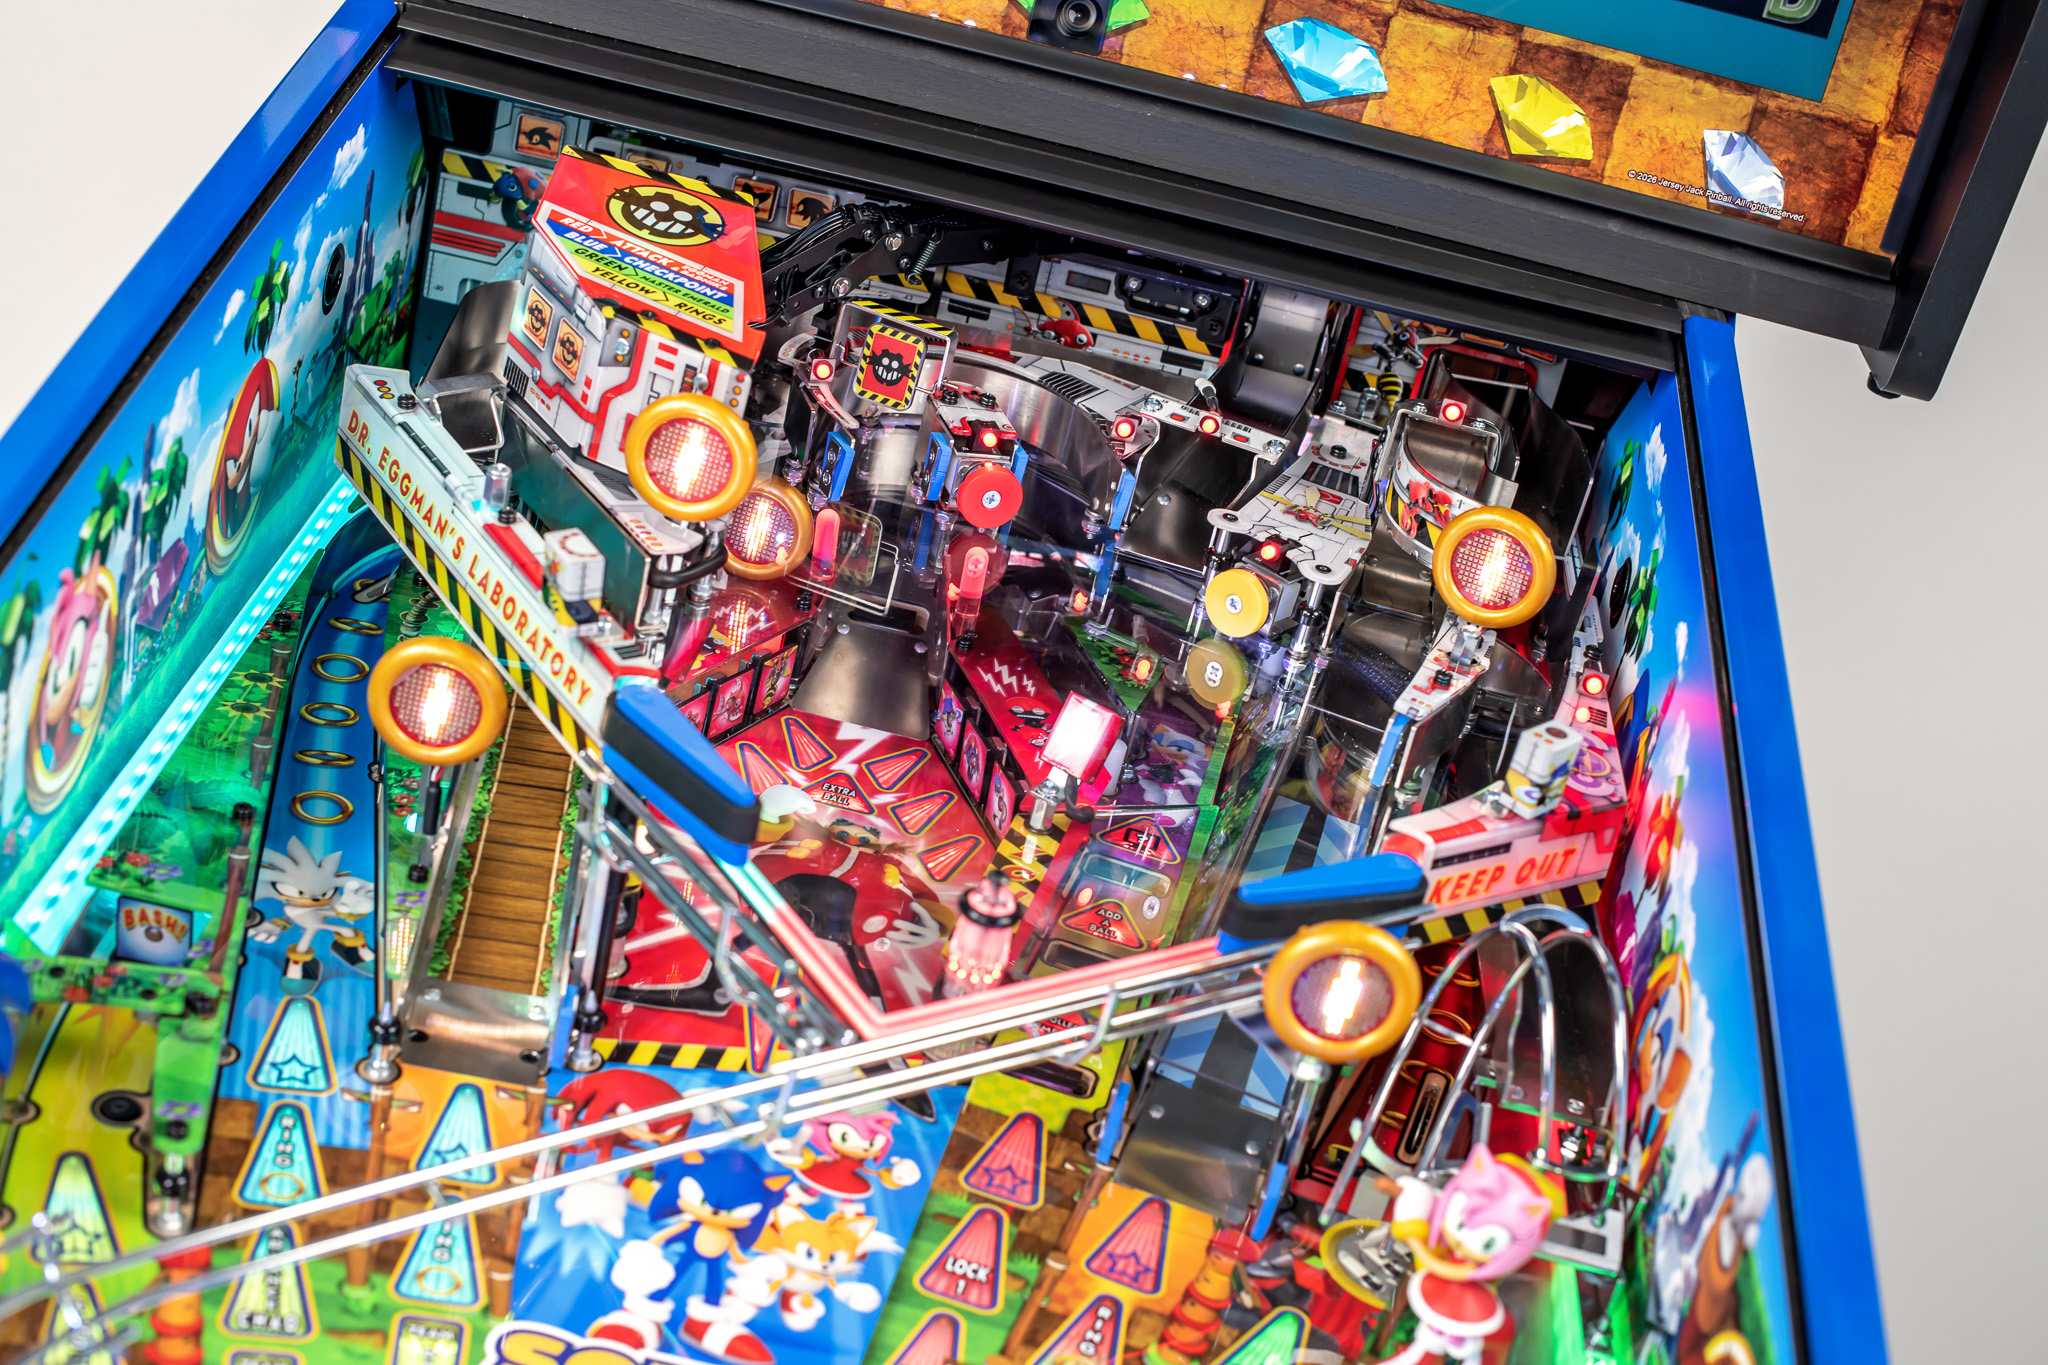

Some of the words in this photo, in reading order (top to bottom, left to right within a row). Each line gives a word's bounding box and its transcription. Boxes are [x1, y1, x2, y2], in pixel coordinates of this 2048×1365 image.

[1636, 172, 1657, 183] 2026
[1658, 178, 1684, 192] Jersey
[1685, 184, 1704, 196] Jack
[1705, 189, 1733, 205] Pinball.
[1735, 197, 1745, 207] All
[1746, 201, 1768, 213] rights
[1769, 207, 1805, 222] reserved.
[560, 217, 593, 233] RED
[609, 240, 673, 266] ATTACK
[564, 231, 608, 251] BLUE
[624, 256, 728, 299] CHECKPOINT
[574, 248, 628, 272] GREEN
[638, 275, 681, 294] MASTER
[682, 292, 730, 314] EMERALD
[680, 270, 729, 291] BADNIKS
[681, 265, 729, 285] EGGMAN
[592, 267, 656, 295] YELLOW
[674, 302, 727, 325] RINGS
[346, 408, 372, 455] DR.
[377, 445, 466, 561] EGGMAN'S
[467, 554, 593, 706] LABORATORY
[822, 783, 856, 797] EXTRA
[823, 793, 849, 805] BALL
[1427, 863, 1506, 904] KEEP
[1514, 846, 1578, 887] OUT
[123, 906, 188, 942] BASH!
[1089, 923, 1116, 937] BALL
[1097, 908, 1121, 920] ADD
[945, 1255, 991, 1283] LOCK
[956, 1279, 966, 1294] 1
